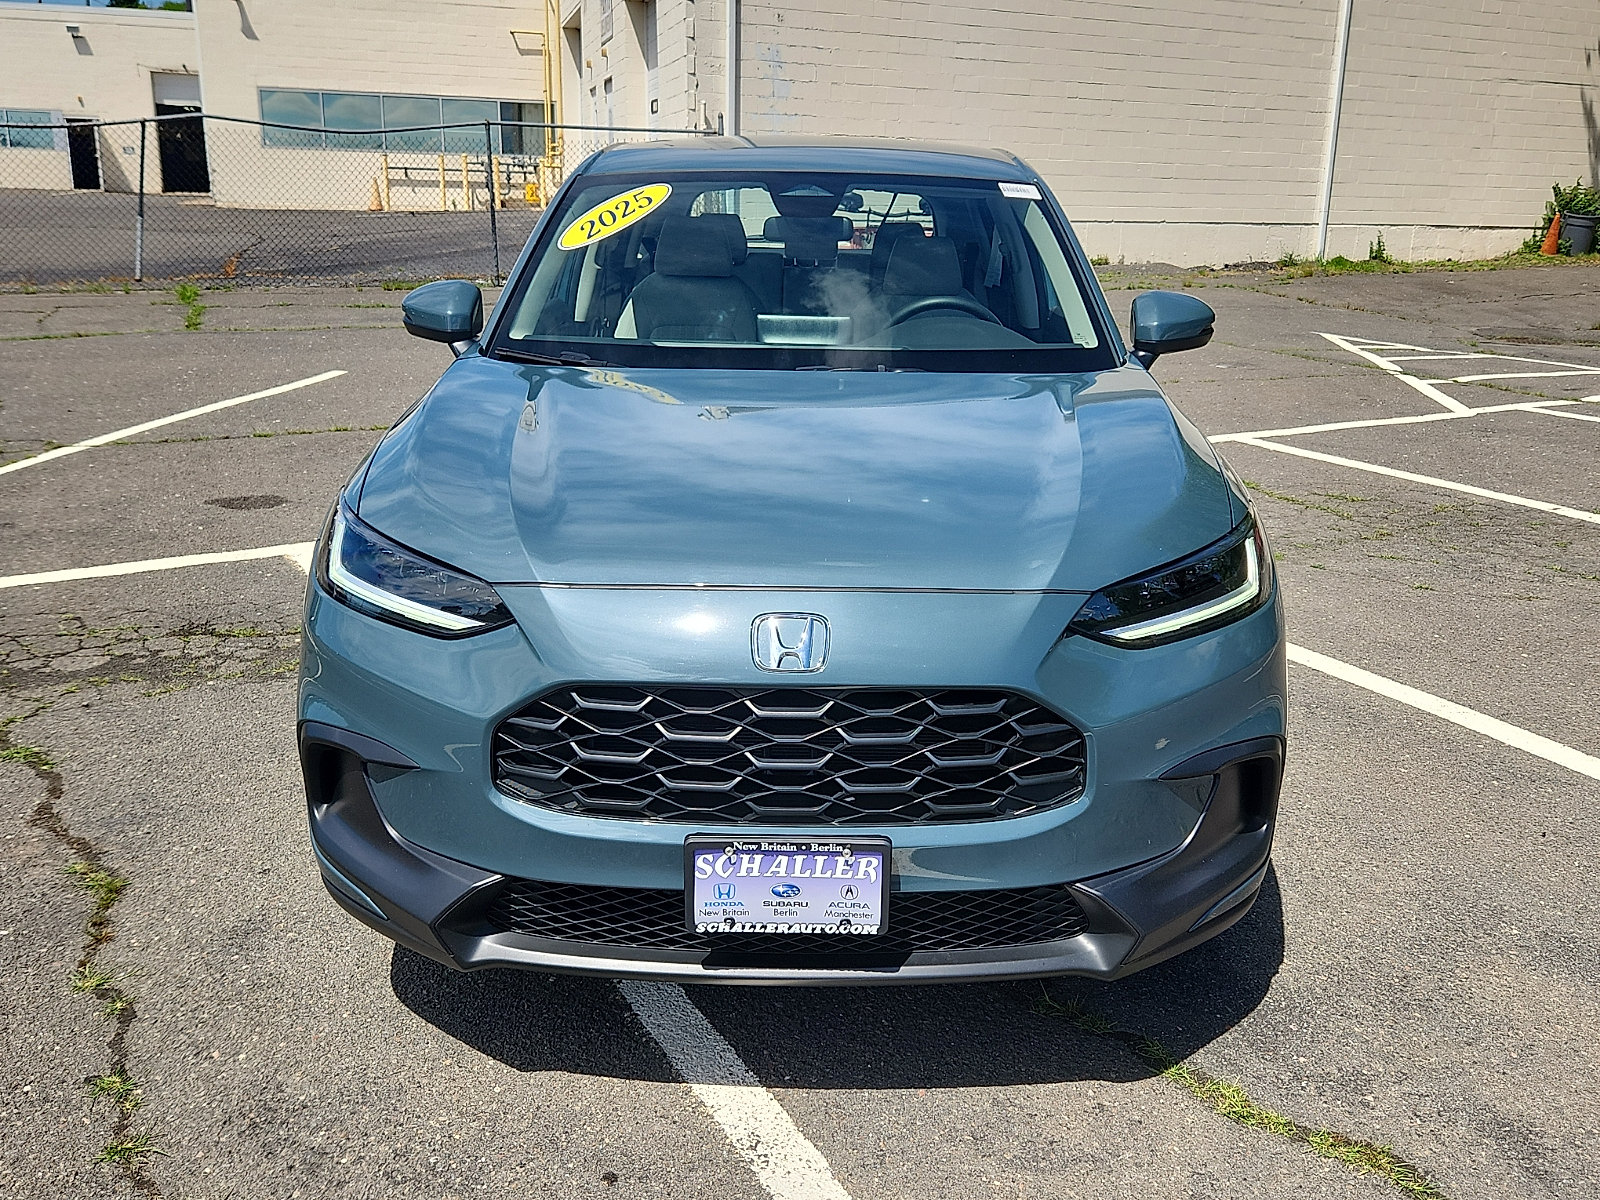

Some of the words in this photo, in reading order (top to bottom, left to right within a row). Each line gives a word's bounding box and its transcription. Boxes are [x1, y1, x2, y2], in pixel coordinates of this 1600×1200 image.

[580, 191, 653, 239] 2025
[733, 842, 758, 850] New
[761, 842, 797, 851] Britain
[810, 843, 843, 852] Berlin
[695, 854, 879, 884] SCHALLER
[824, 910, 874, 919] Manchester
[695, 922, 880, 935] SCHALLERAUTO.COM
